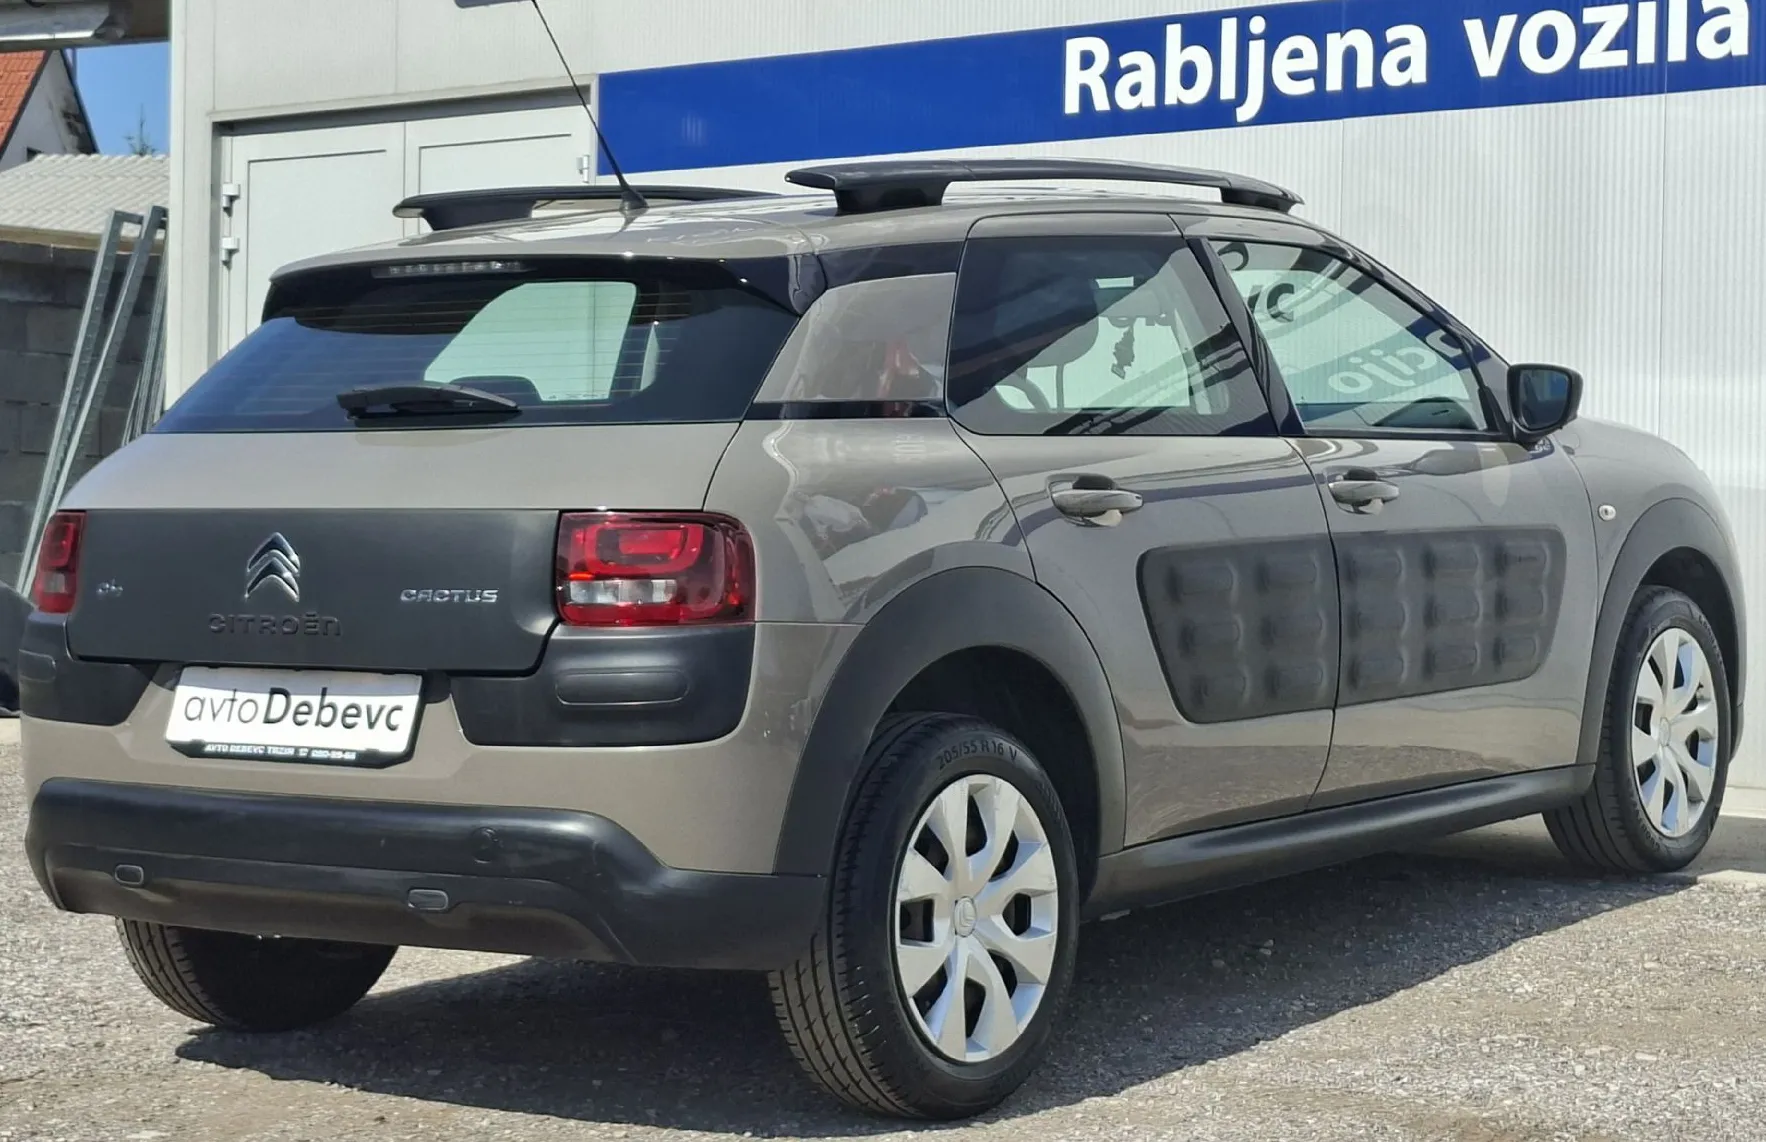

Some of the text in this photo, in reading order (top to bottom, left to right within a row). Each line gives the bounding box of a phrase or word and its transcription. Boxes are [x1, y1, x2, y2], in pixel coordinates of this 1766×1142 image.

[1064, 0, 1749, 122] Rabljena vozila
[400, 589, 499, 603] CACTUS
[204, 743, 229, 754] AVTO
[940, 741, 978, 769] 205/55
